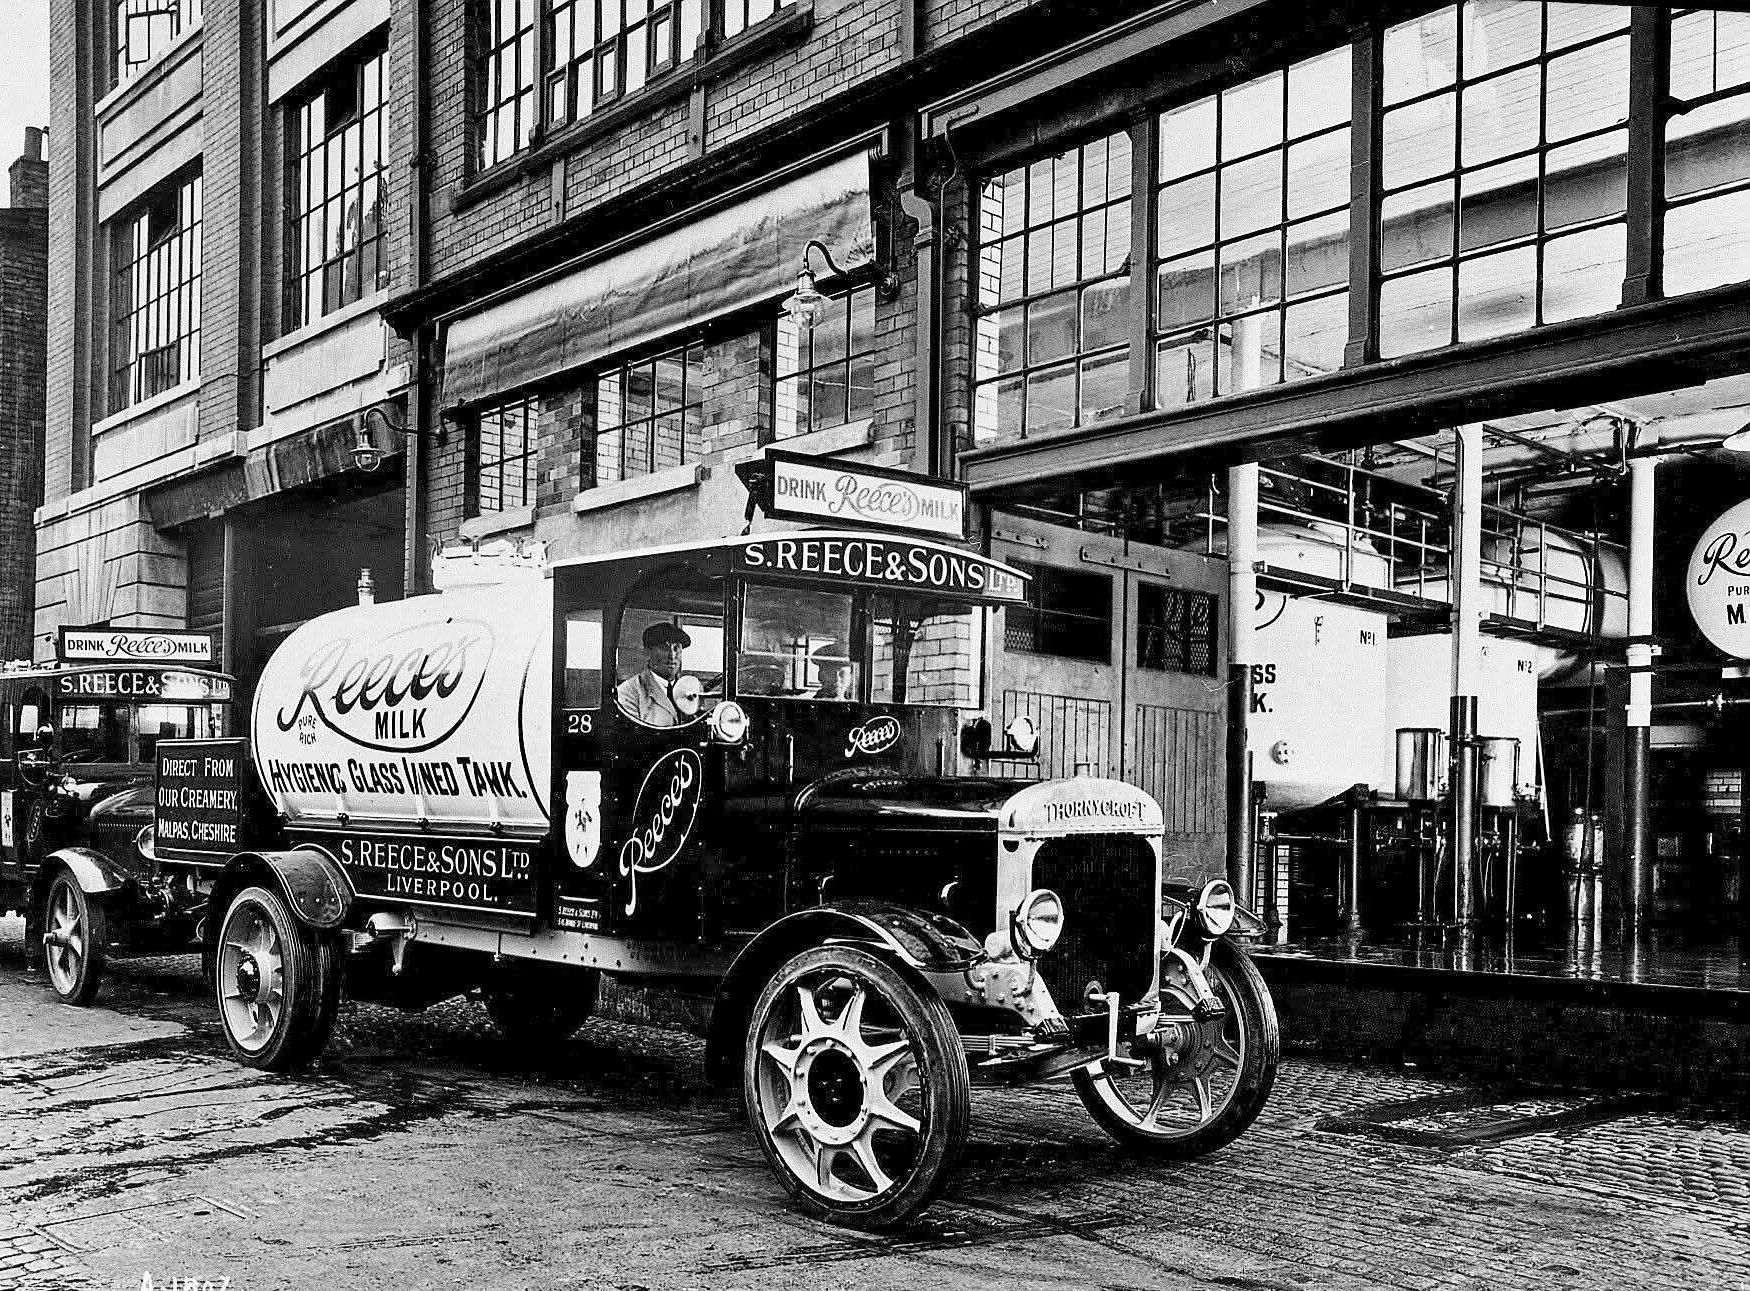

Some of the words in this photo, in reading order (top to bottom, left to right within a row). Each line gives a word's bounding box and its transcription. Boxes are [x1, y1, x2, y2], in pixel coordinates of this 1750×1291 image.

[777, 476, 826, 503] DRINK
[828, 475, 917, 520] Reece's
[921, 499, 959, 521] MILK
[67, 639, 104, 651] DRINK
[106, 634, 175, 657] Reece's
[178, 642, 208, 653] MILK
[298, 714, 317, 730] PURE
[375, 708, 427, 739] MILK
[568, 714, 592, 733] 28
[162, 757, 197, 776] DIRECT
[204, 757, 233, 777] FROM
[347, 758, 405, 795] GLASS
[158, 786, 178, 807] OUR
[1043, 800, 1146, 823] THORNYCROFT
[191, 820, 237, 843] CHESHIRE
[620, 752, 698, 917] Reece's
[387, 873, 498, 902] LIVERPOOL.
